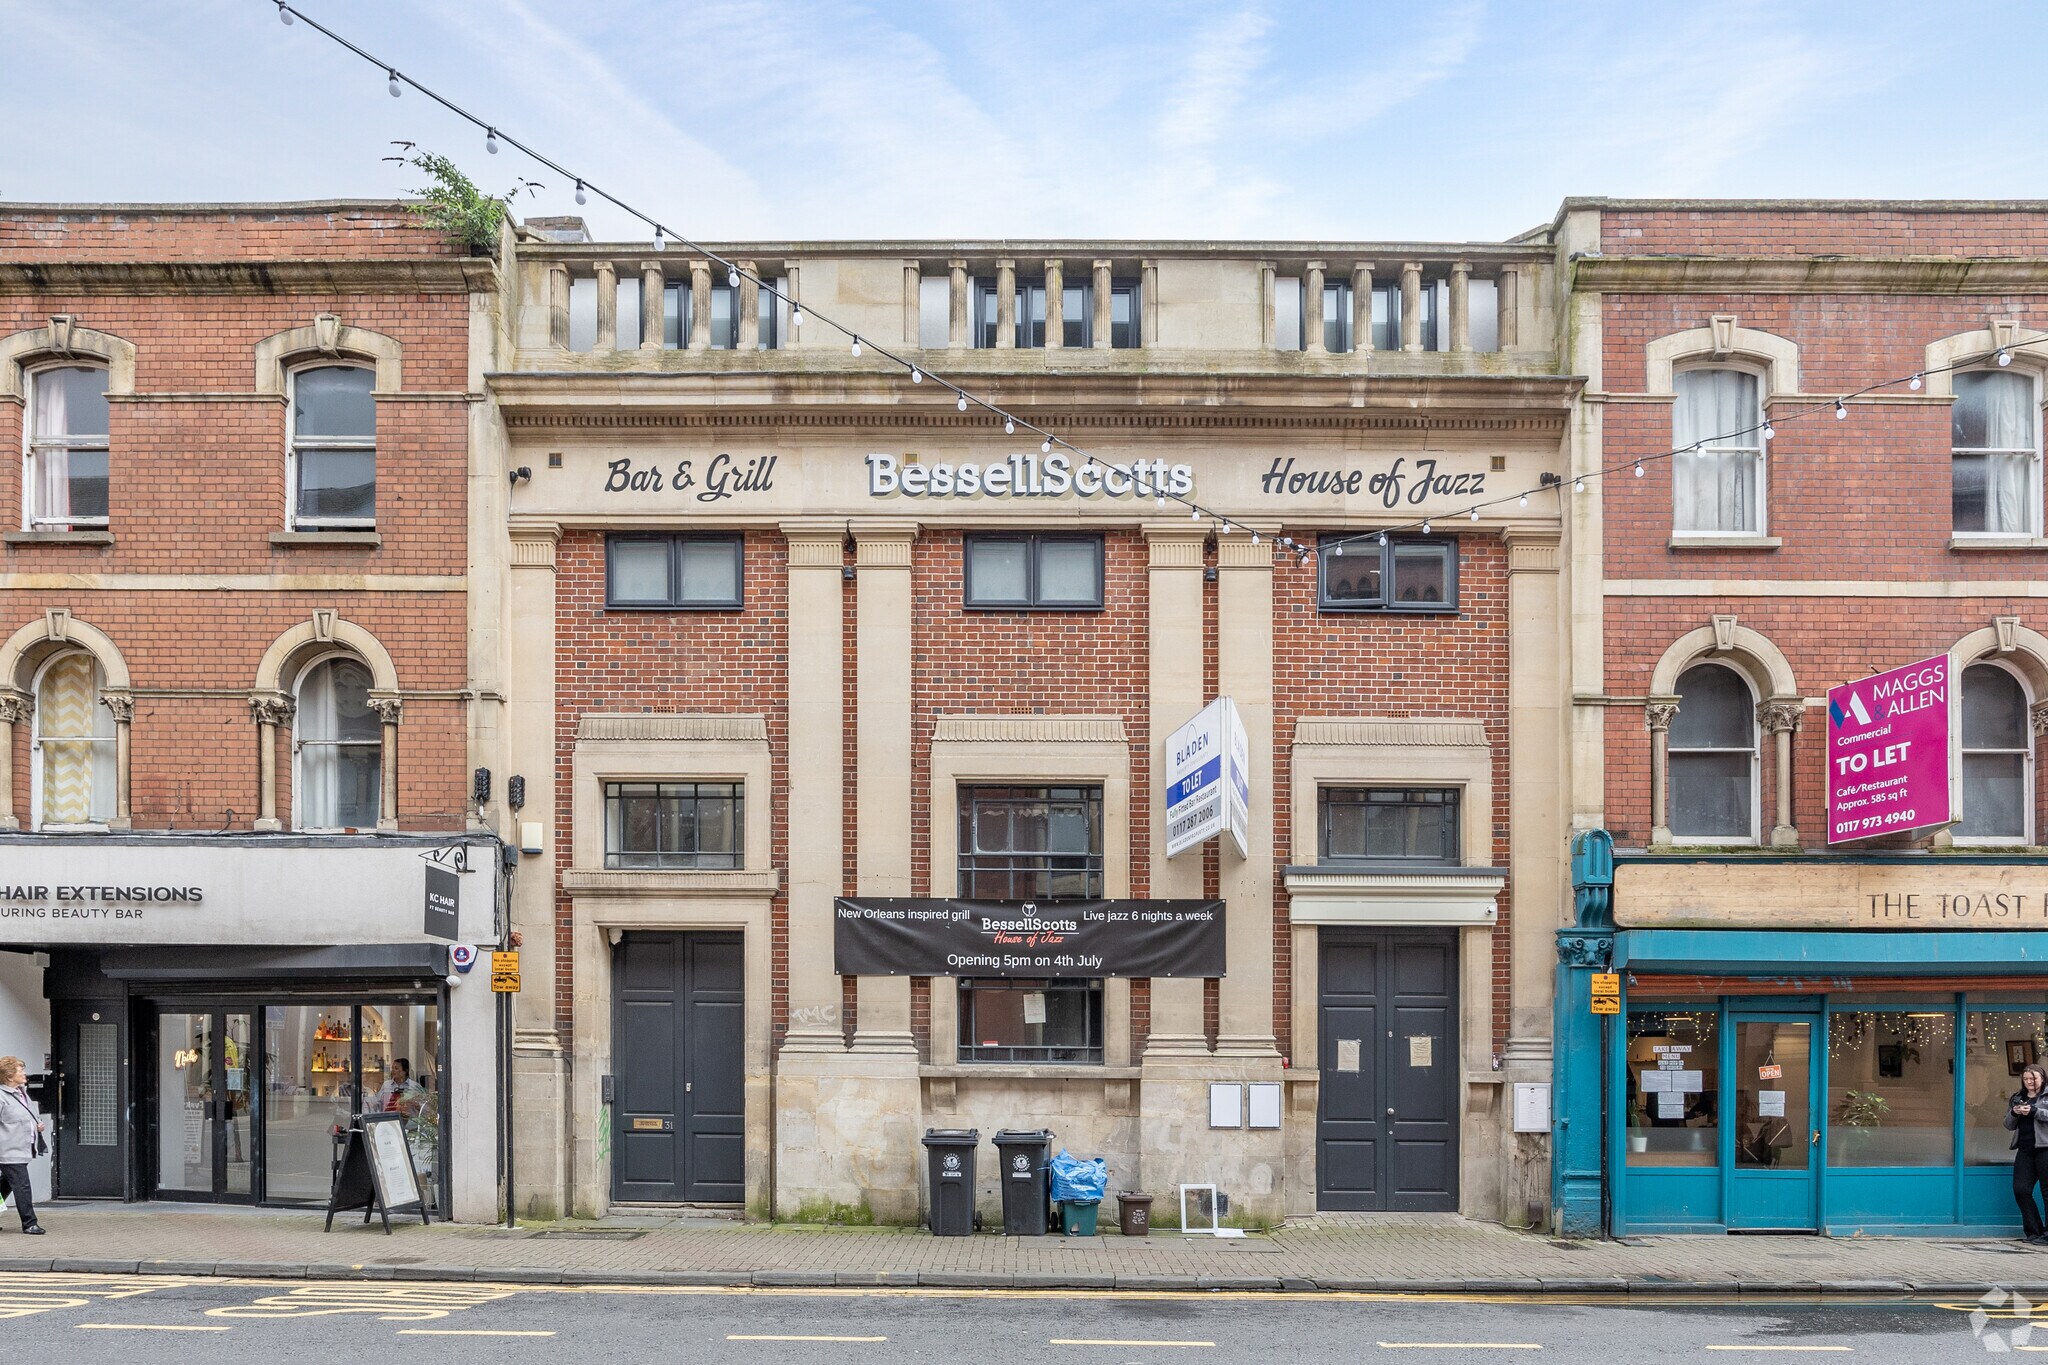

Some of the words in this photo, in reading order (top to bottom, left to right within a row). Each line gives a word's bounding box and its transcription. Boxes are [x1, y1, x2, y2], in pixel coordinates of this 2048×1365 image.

[604, 458, 664, 492] Bar
[672, 460, 696, 491] &
[696, 453, 778, 502] Grill
[865, 453, 1194, 497] BessellScotts
[1262, 457, 1363, 495] House
[1368, 457, 1406, 509] of
[1407, 459, 1485, 505] Jazz
[1873, 664, 1944, 701] MAGGS
[1873, 704, 1886, 721] &
[1887, 686, 1944, 718] ALLEN
[1837, 724, 1892, 747] Commercial
[1176, 731, 1209, 766] BLADEN
[1836, 753, 1868, 776] TO
[1873, 741, 1911, 768] LET
[1182, 775, 1192, 795] TO
[1192, 770, 1202, 788] LET
[1836, 775, 1908, 798] Café/Restaurant
[1196, 786, 1217, 805] Restaurant
[1836, 798, 1869, 812] Approx.
[1871, 793, 1886, 804] 585
[1887, 792, 1898, 804] sq
[1899, 788, 1908, 798] ft
[1172, 820, 1186, 837] 0117
[1186, 814, 1197, 830] 287
[1198, 806, 1213, 823] 2006
[1836, 819, 1860, 834] 0117
[1862, 815, 1883, 829] 973
[1884, 809, 1915, 825] 4940
[0, 885, 49, 901] HAIR
[56, 886, 203, 902] EXTENSIONS
[430, 892, 439, 903] KC
[440, 895, 455, 907] HAIR
[1, 908, 46, 918] URING
[52, 908, 110, 919] BEAUTY
[115, 909, 143, 919] BAR
[838, 908, 861, 918] New
[864, 908, 905, 919] Orleans
[907, 909, 949, 921] inspired
[951, 910, 970, 922] grill
[1083, 911, 1105, 921] Live
[1107, 911, 1129, 923] jazz
[1131, 911, 1139, 921] 6
[1141, 911, 1172, 923] nights
[1175, 913, 1183, 921] a
[1185, 911, 1213, 921] week
[1866, 893, 1920, 919] THE
[1936, 893, 2028, 919] TOAST
[981, 917, 1077, 931] BessellScotts
[994, 930, 1022, 944] House
[1026, 930, 1038, 947] of
[1041, 930, 1065, 944] Jazz
[947, 954, 1000, 968] Opening
[1003, 954, 1031, 968] 5pm
[1034, 956, 1050, 966] on
[1054, 955, 1074, 967] 4th
[1077, 955, 1103, 969] July
[1762, 1070, 1780, 1078] OPEN
[664, 1121, 674, 1130] 31
